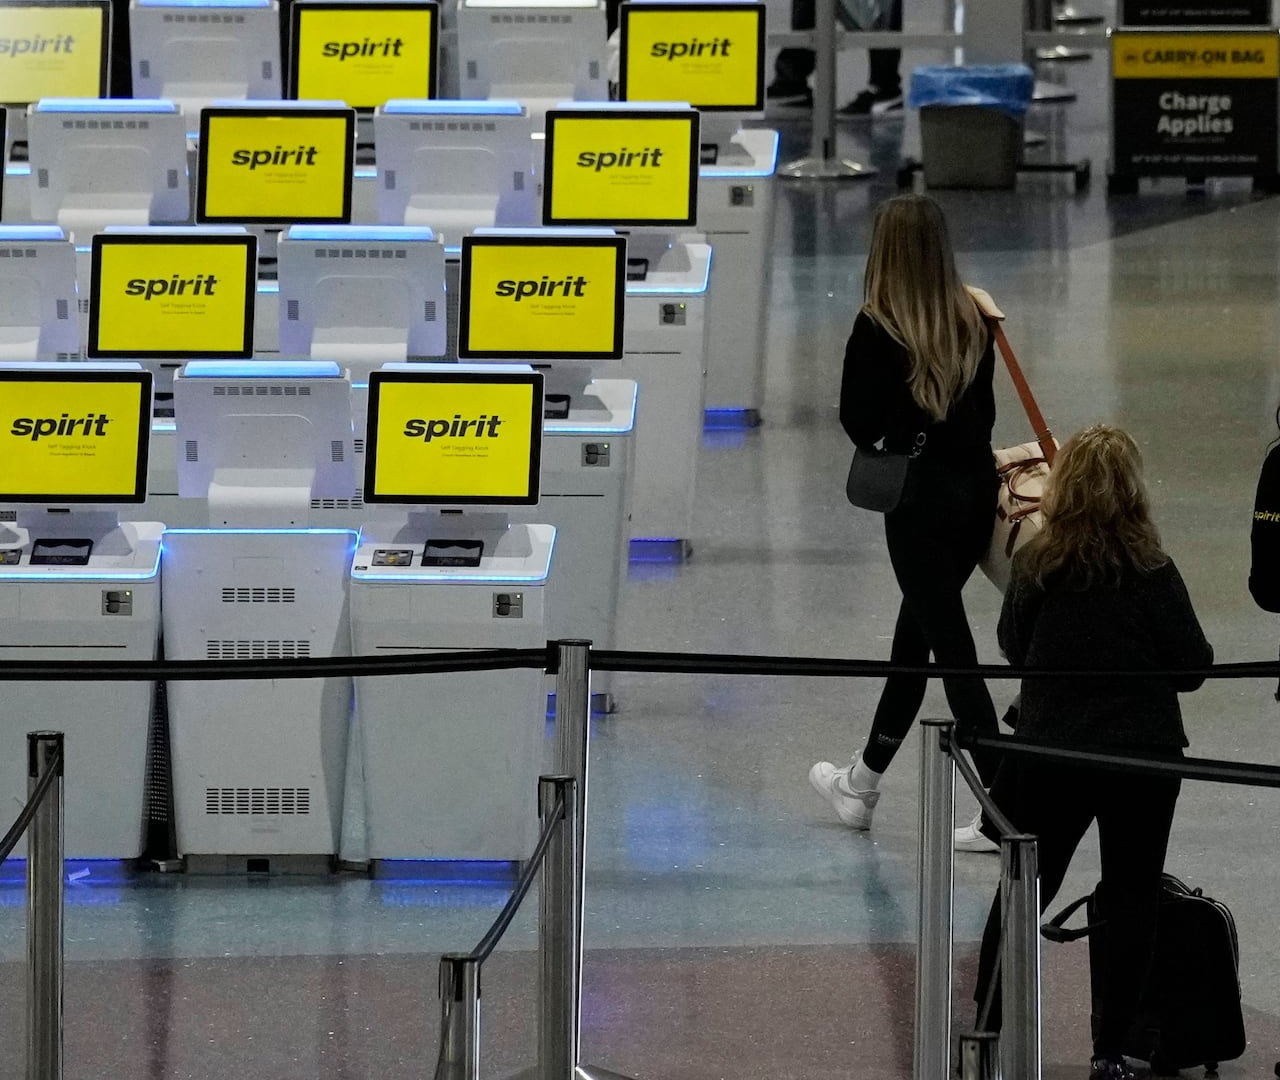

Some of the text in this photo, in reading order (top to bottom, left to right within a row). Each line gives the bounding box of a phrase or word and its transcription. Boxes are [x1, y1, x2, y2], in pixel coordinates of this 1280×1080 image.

[321, 37, 403, 62] spirit
[650, 37, 732, 62] spirit
[1142, 49, 1265, 64] CARRY-ON BAG
[1158, 92, 1231, 115] Charge
[1156, 114, 1234, 137] Applies
[231, 145, 318, 170] spirit
[576, 147, 663, 172] spirit
[124, 274, 218, 301] spirit
[494, 275, 587, 302] spirit
[10, 413, 110, 441] spirit
[403, 414, 502, 442] spirit
